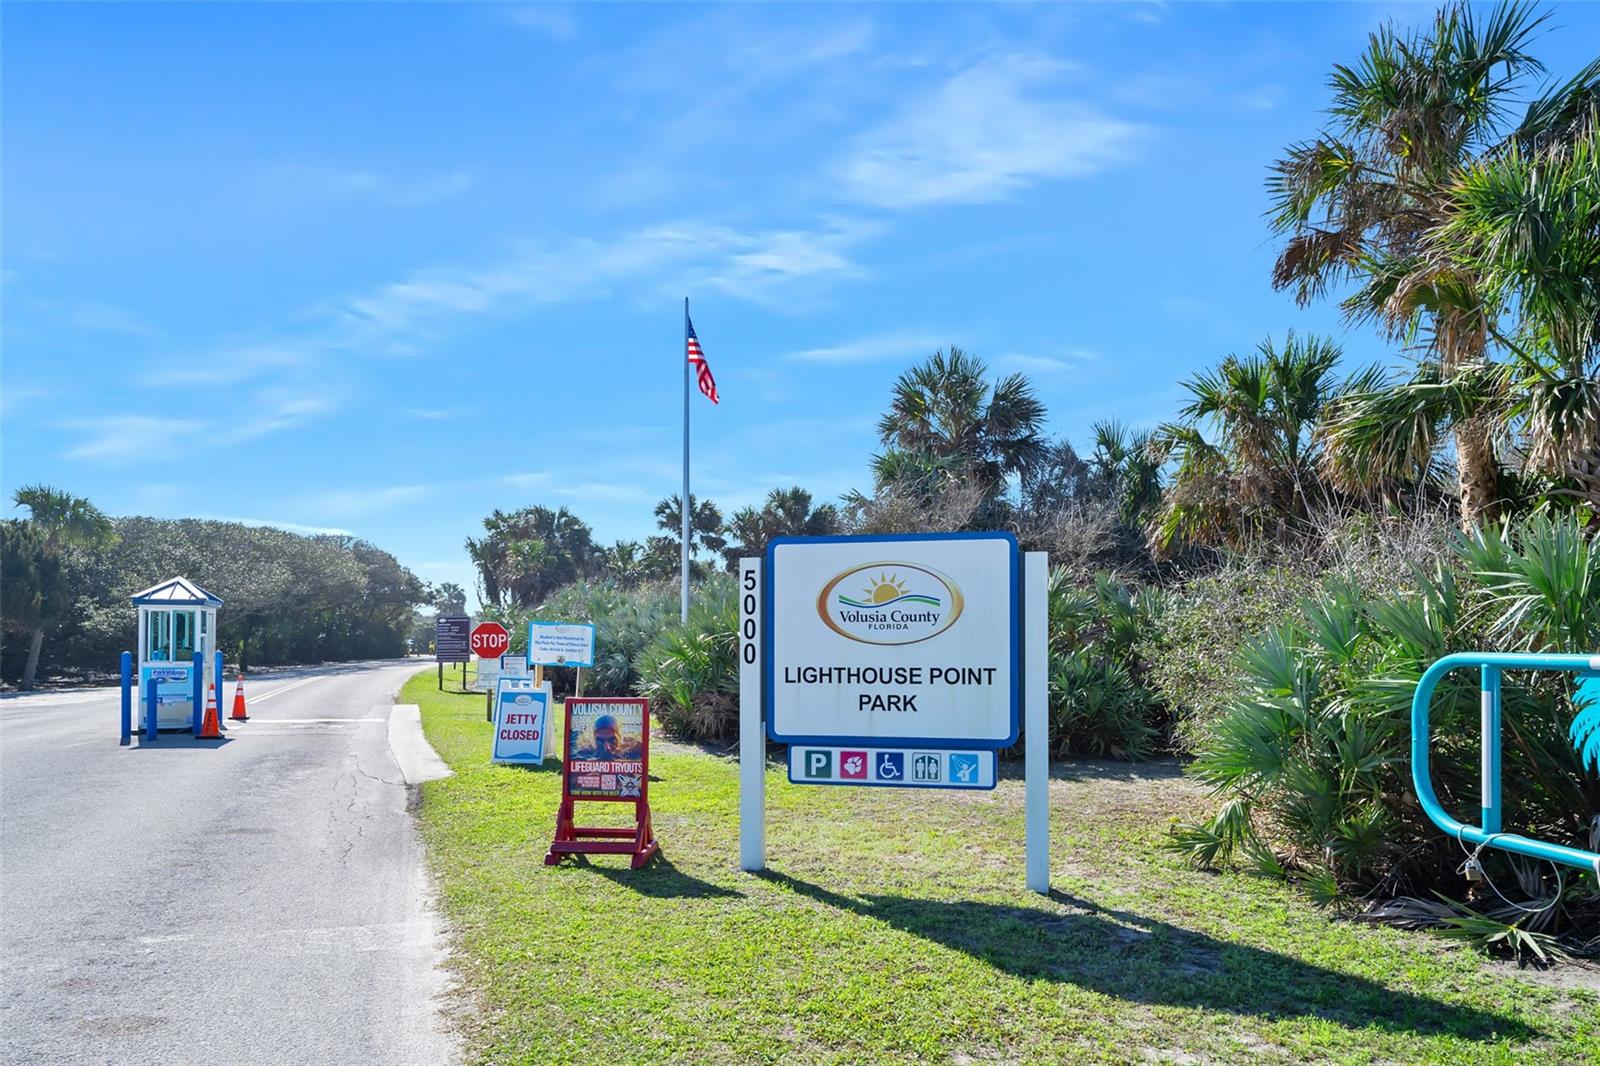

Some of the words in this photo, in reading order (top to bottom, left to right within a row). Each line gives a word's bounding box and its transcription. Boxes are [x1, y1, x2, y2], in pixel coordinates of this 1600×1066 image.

[743, 570, 756, 664] 5000
[839, 610, 887, 623] Volusia
[891, 610, 940, 626] County
[473, 634, 507, 648] STOP
[785, 667, 922, 685] LIGHTHOUSE
[930, 667, 996, 685] POINT
[572, 703, 607, 715] VOLUSIA
[609, 703, 643, 716] COUNTY
[858, 694, 918, 712] PARK
[506, 713, 538, 725] JETTY
[500, 729, 540, 741] CLOSED
[570, 761, 610, 773] LIFEGUARD
[611, 762, 643, 773] TRYOUTS
